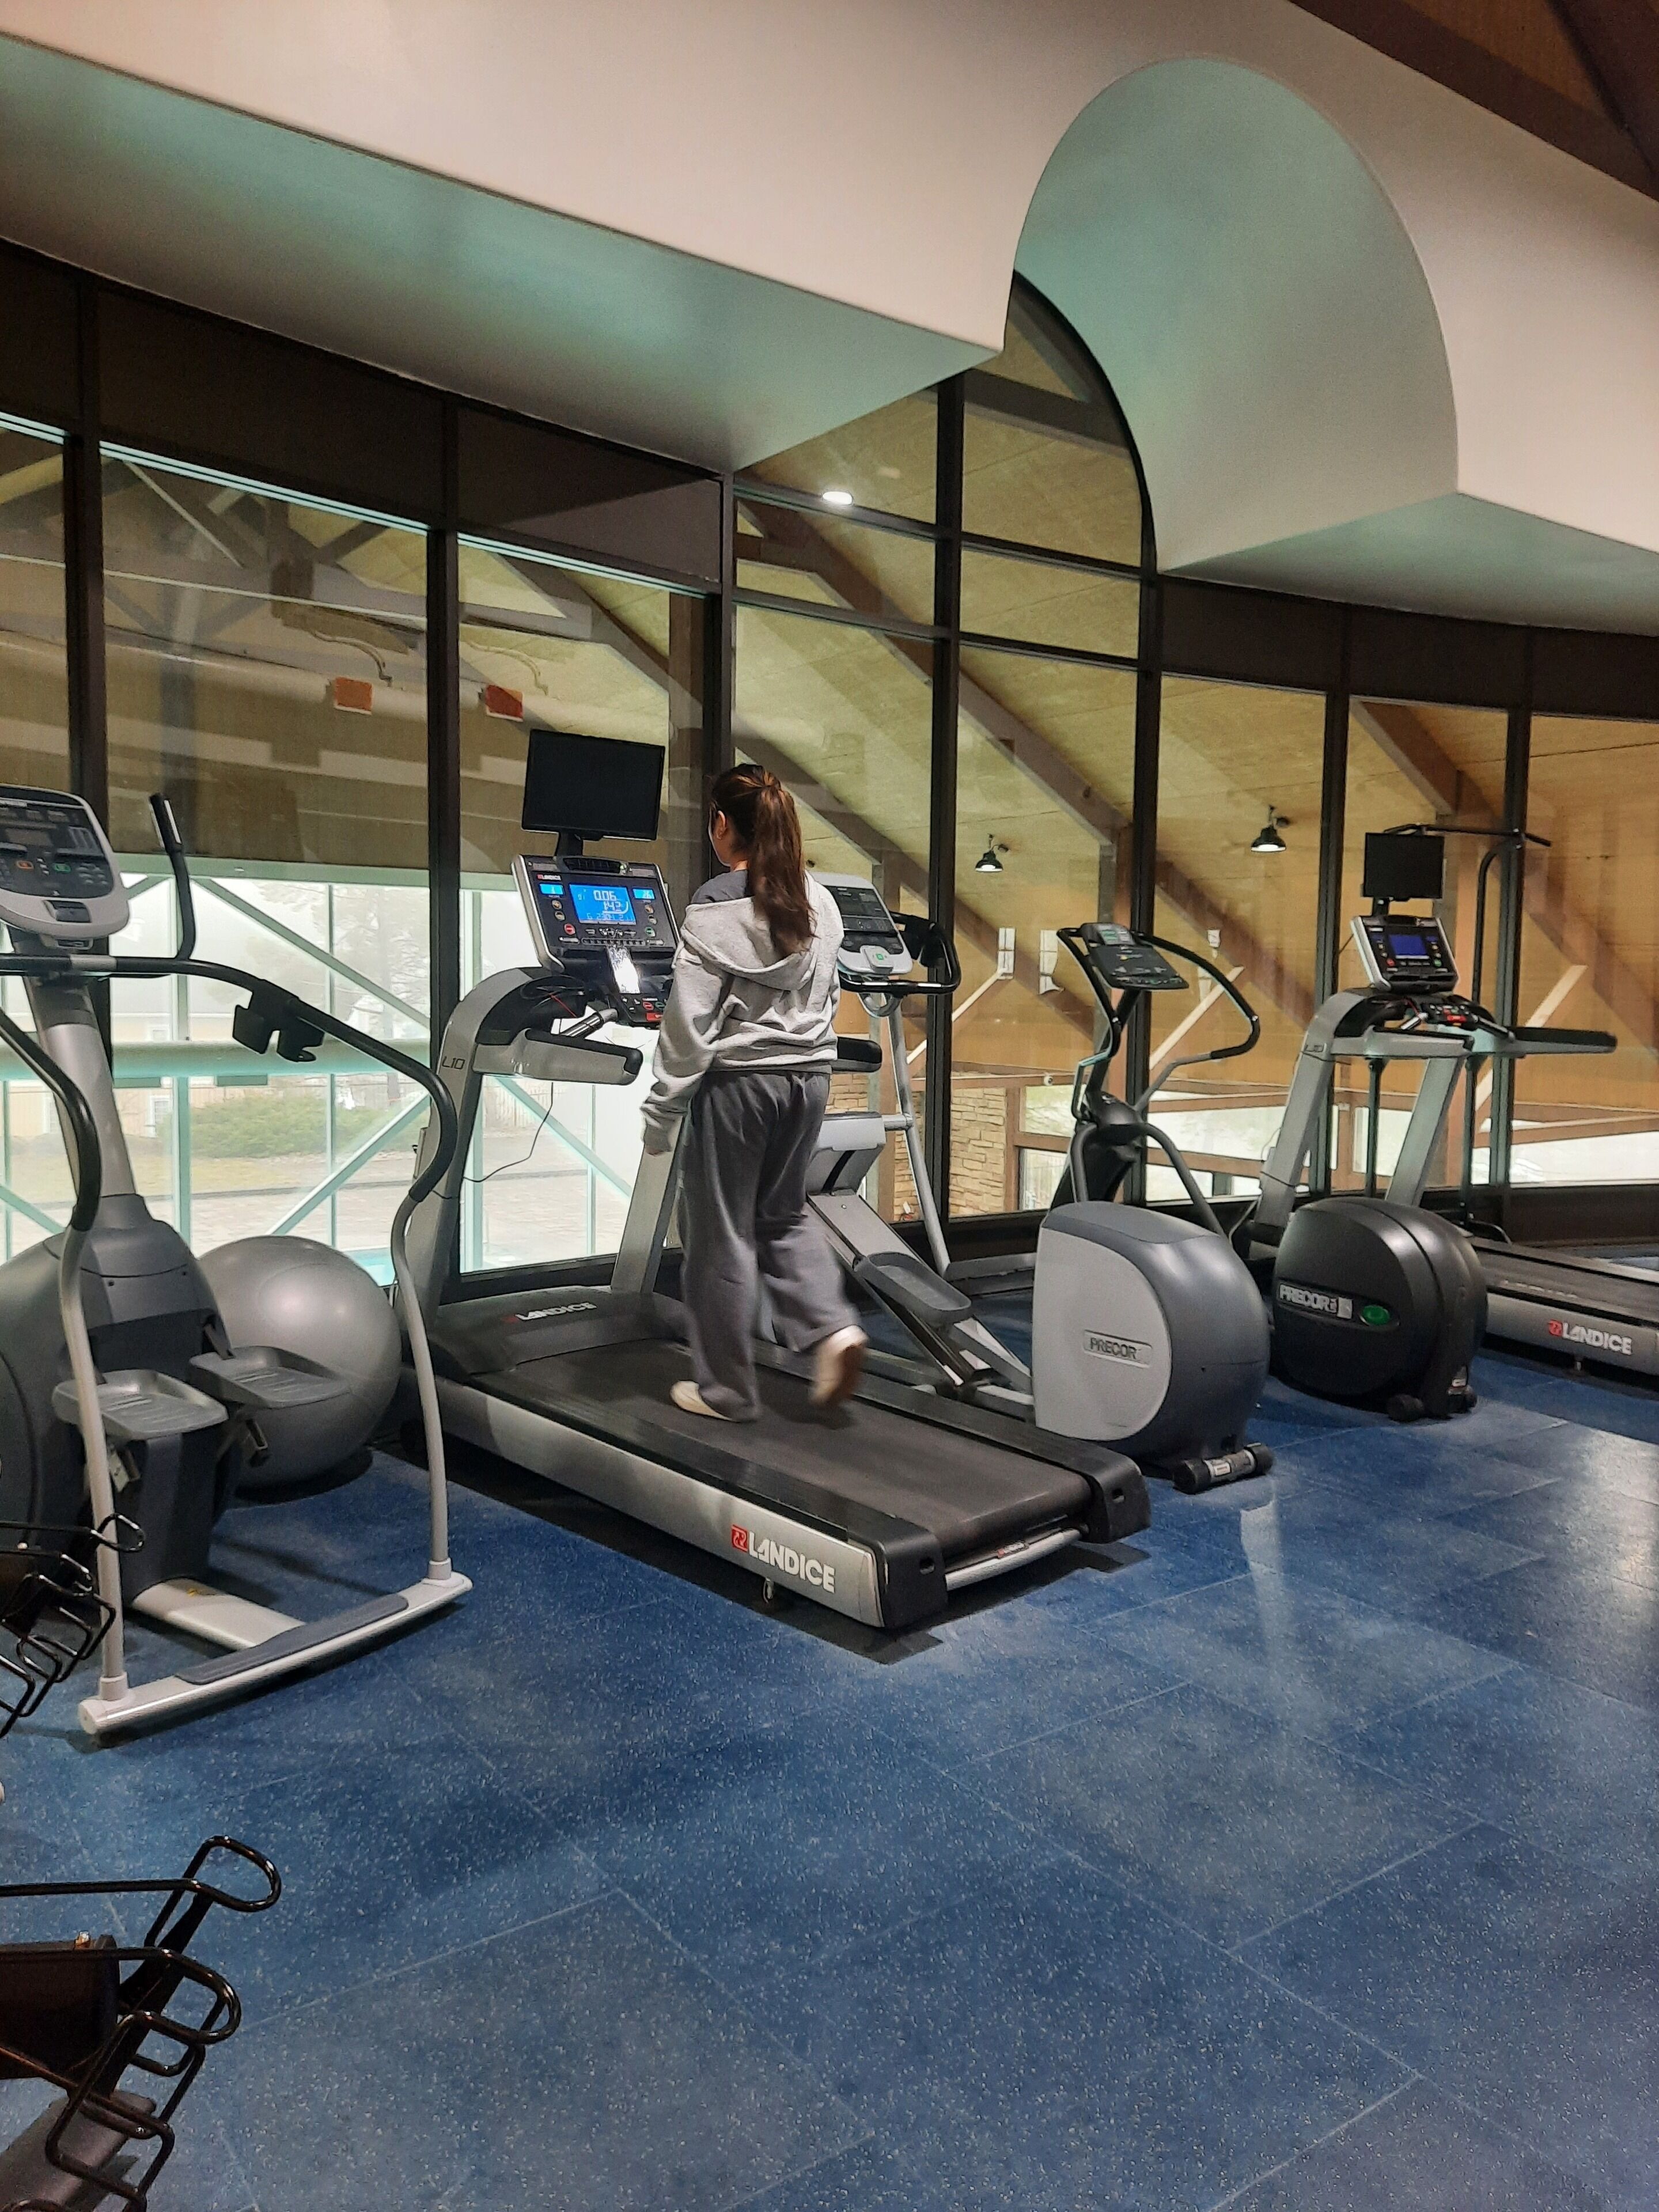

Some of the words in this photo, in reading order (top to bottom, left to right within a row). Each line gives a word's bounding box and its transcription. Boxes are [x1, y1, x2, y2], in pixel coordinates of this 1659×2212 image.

[442, 1055, 466, 1070] L10
[1279, 1284, 1330, 1312] PRECOR
[1090, 1337, 1137, 1360] PRECOR
[1562, 1322, 1633, 1355] LANDICE
[749, 1531, 835, 1594] LANDICE
